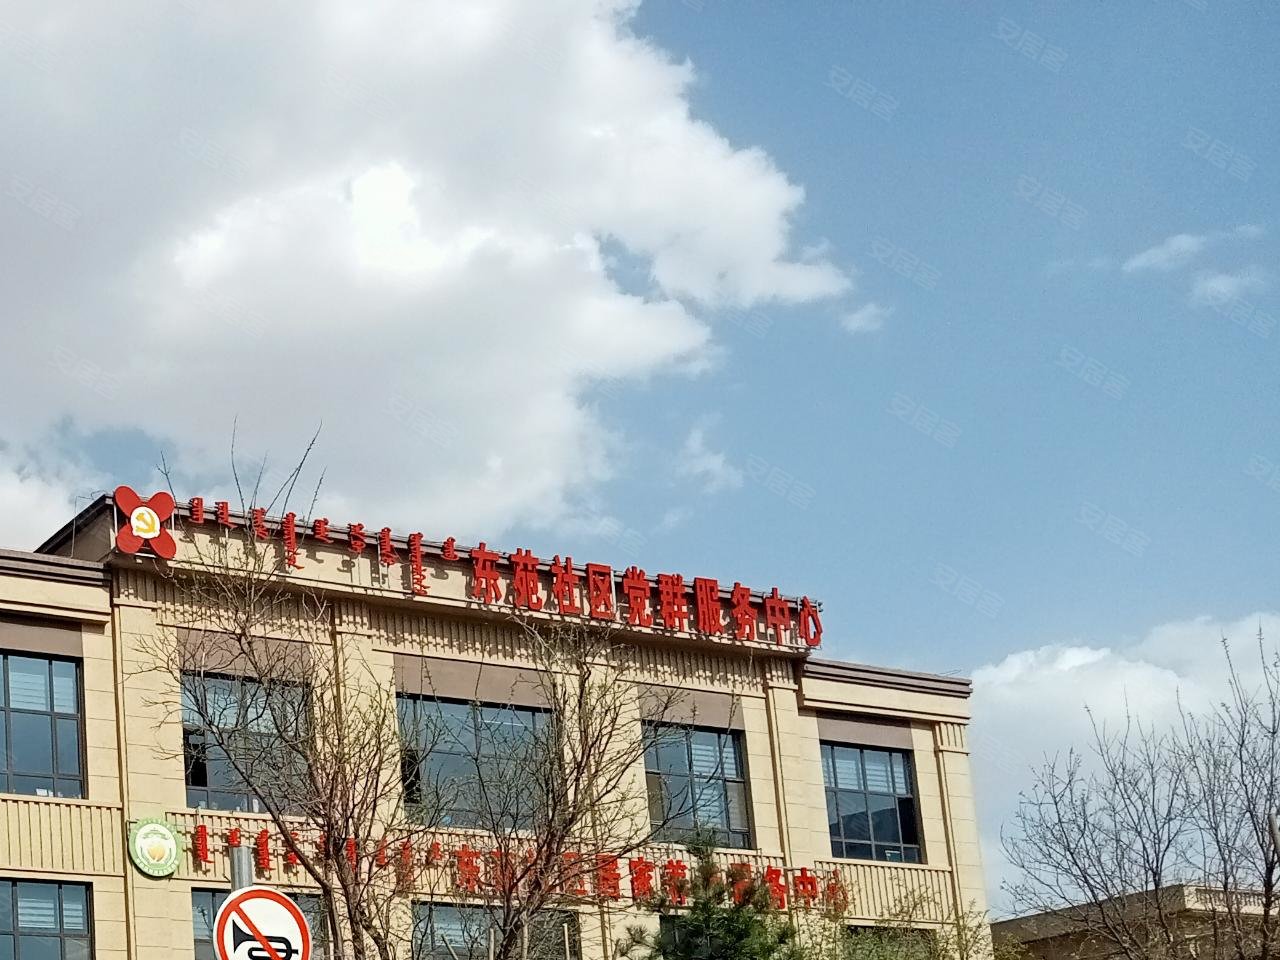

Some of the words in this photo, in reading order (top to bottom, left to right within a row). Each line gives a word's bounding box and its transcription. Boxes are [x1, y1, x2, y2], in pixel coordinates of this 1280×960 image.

[471, 542, 823, 647] 东苑社区党群服务中心
